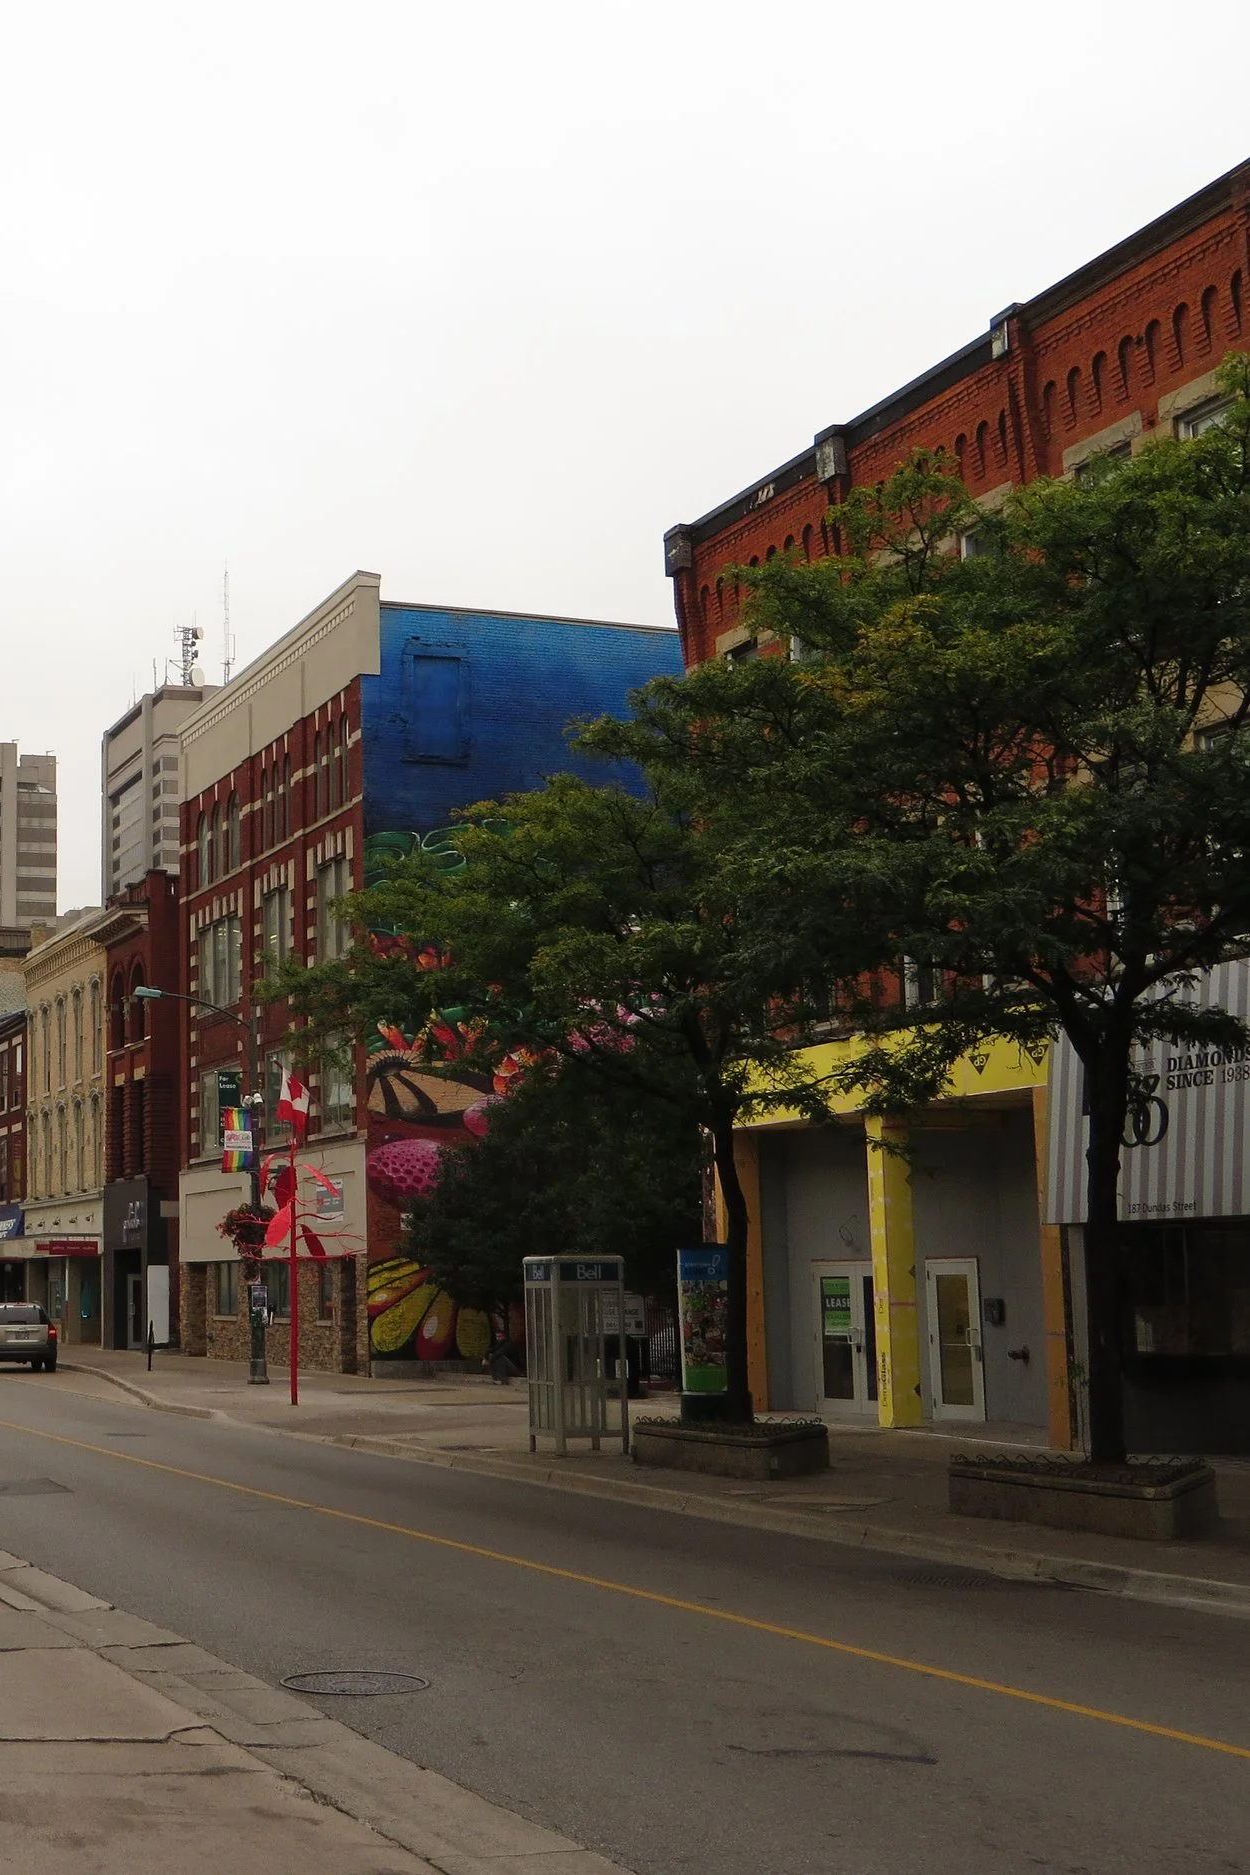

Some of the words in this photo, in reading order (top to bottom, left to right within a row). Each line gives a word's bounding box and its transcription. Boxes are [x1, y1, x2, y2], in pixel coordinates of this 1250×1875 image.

[1167, 1046, 1250, 1072] DIAMONDS
[1166, 1070, 1213, 1090] SINCE
[1221, 1065, 1250, 1083] 1938
[1173, 1200, 1197, 1212] Street
[533, 1264, 545, 1280] Bell
[576, 1264, 602, 1280] Bell
[825, 1298, 850, 1308] LEASE
